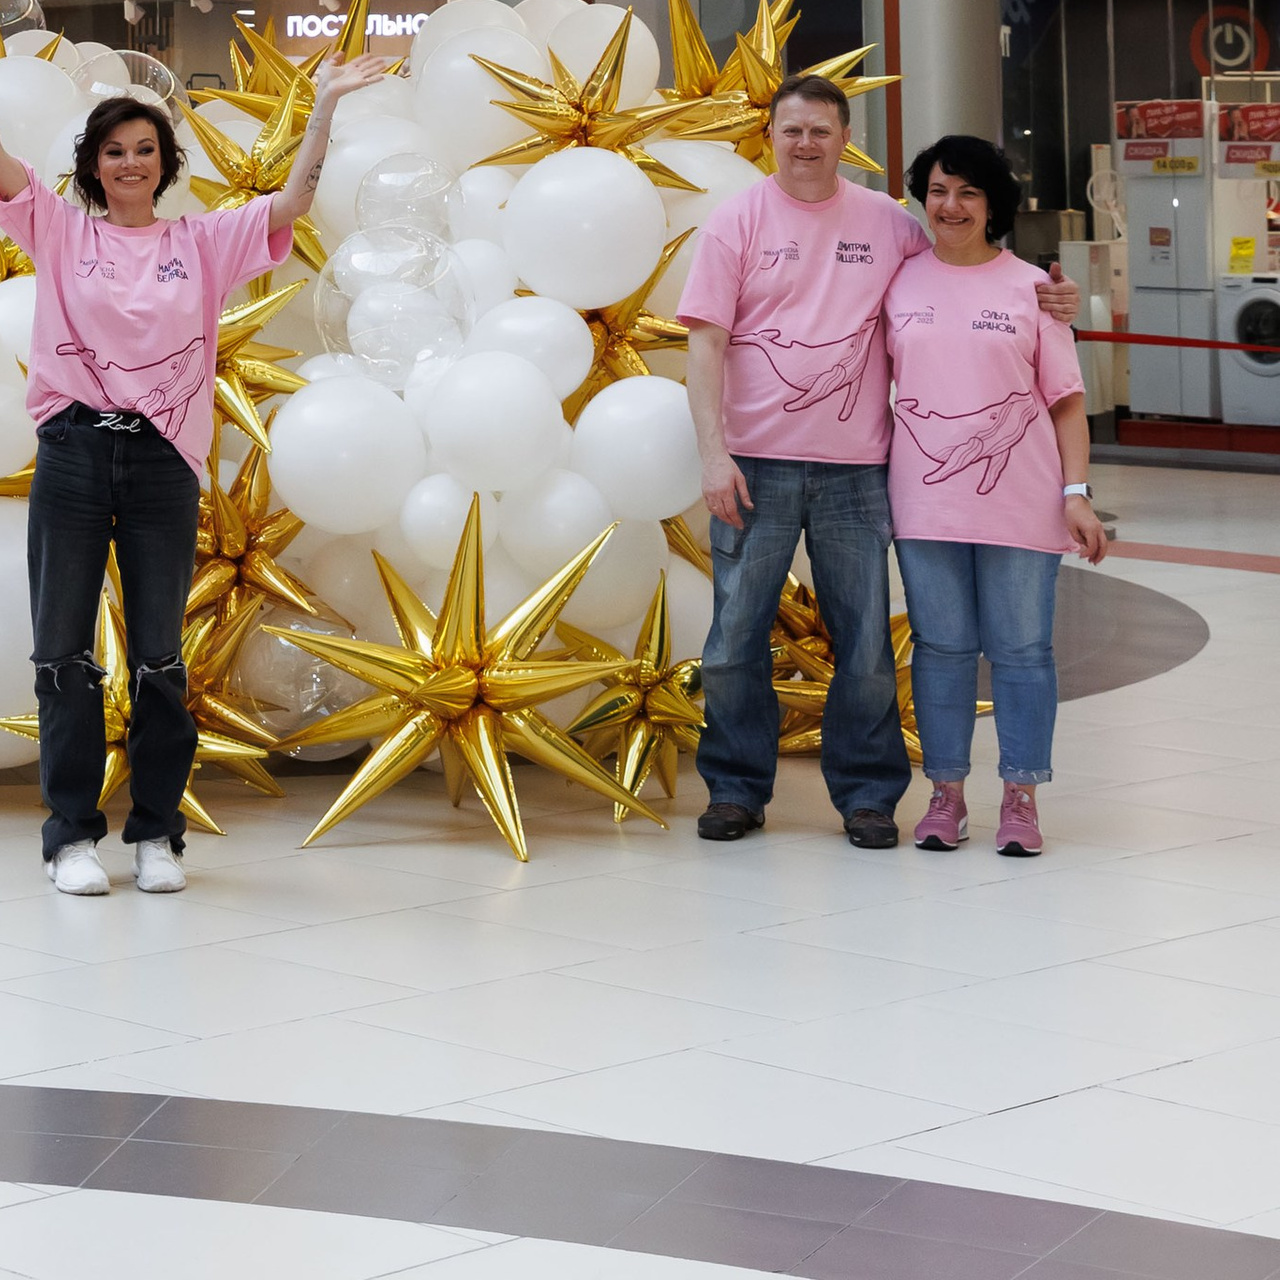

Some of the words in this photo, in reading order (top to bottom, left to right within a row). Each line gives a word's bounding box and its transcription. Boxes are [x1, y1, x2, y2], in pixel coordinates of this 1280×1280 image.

[837, 241, 871, 253] ДМИТРИЙ
[981, 309, 1010, 321] ОЛЬГА
[972, 320, 1017, 335] БАРАНОВА
